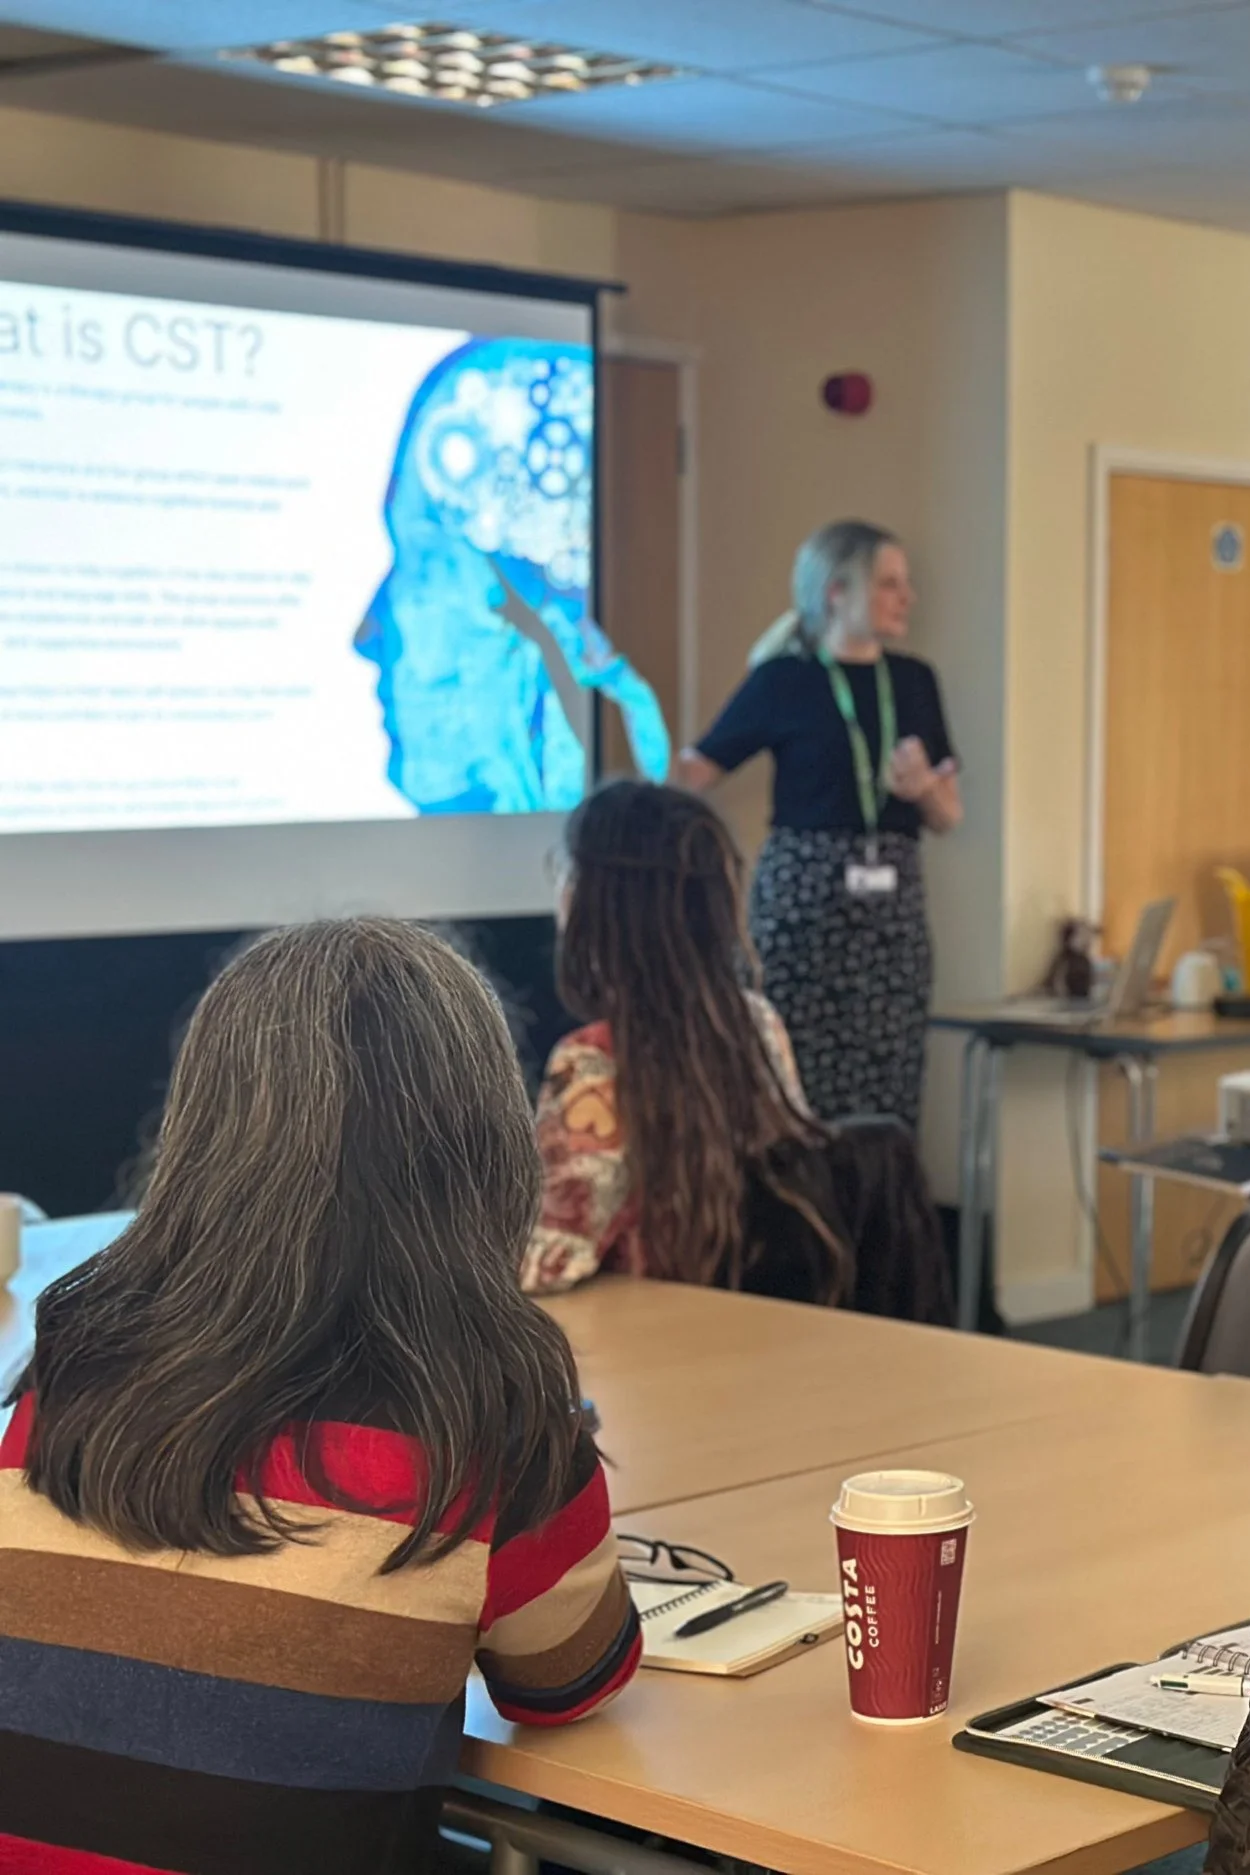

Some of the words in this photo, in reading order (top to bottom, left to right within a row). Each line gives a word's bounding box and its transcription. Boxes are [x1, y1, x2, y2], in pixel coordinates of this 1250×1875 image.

[61, 303, 104, 363] is
[124, 311, 265, 377] CST?
[842, 1558, 864, 1670] COSTA
[865, 1585, 880, 1648] COFFEE
